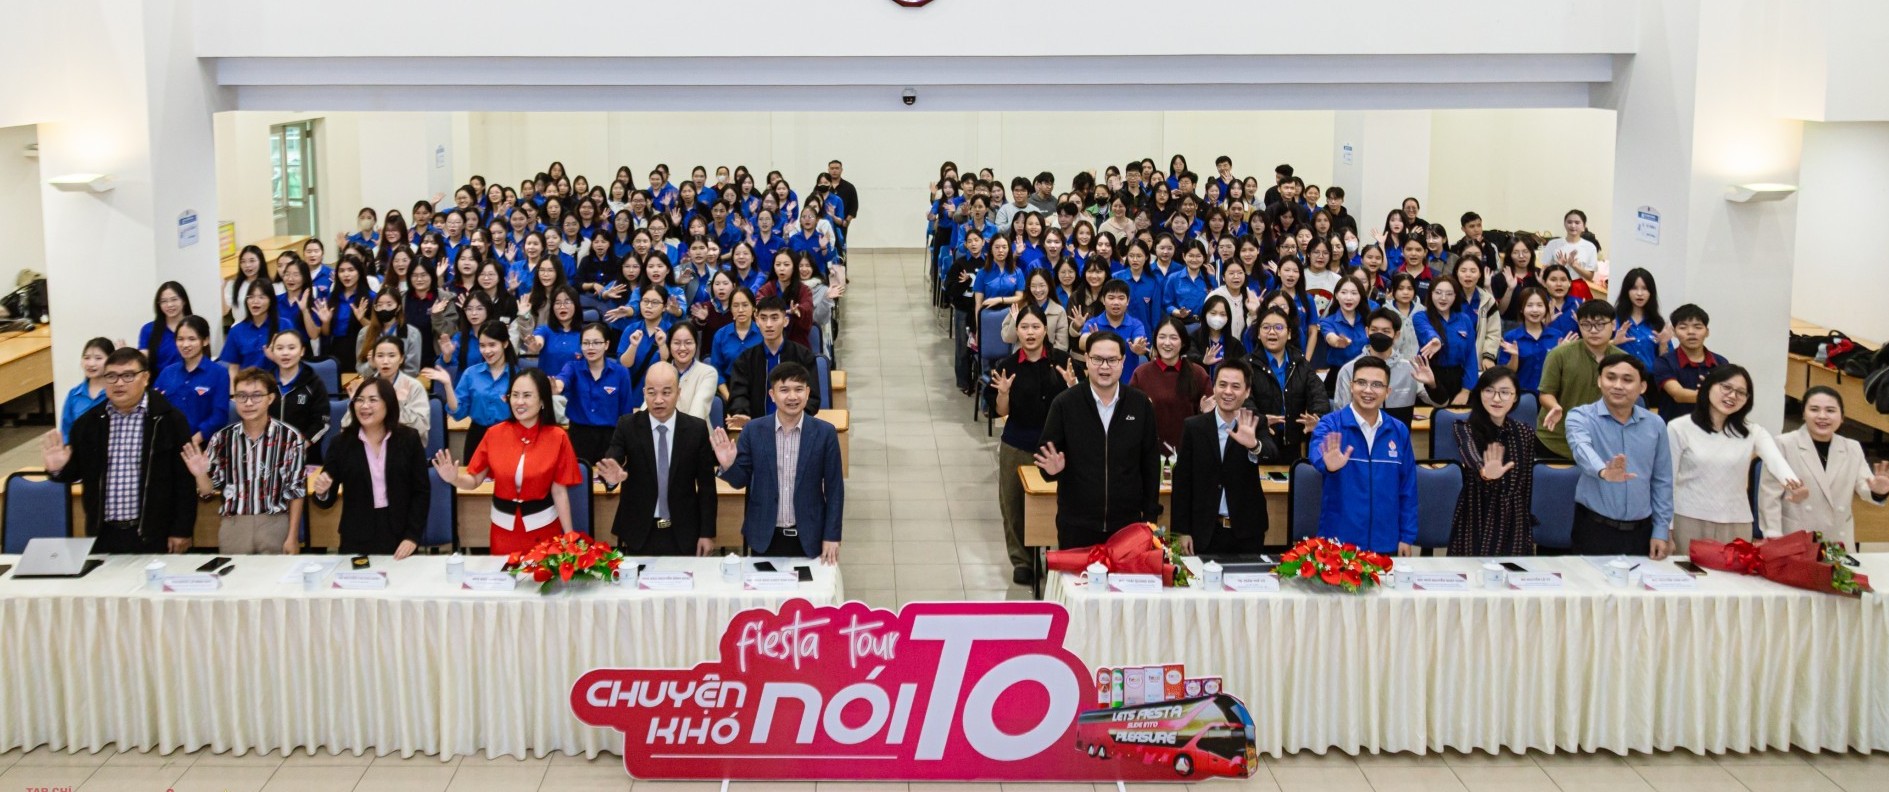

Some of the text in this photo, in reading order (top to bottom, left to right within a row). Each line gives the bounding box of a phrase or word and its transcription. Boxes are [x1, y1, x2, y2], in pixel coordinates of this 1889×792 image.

[737, 610, 900, 672] fiesta tour
[586, 673, 748, 715] CHUYỆN
[645, 711, 740, 745] KHÓ
[1112, 705, 1183, 722] LETS FIESTA
[1115, 731, 1178, 745] PLEASURE
